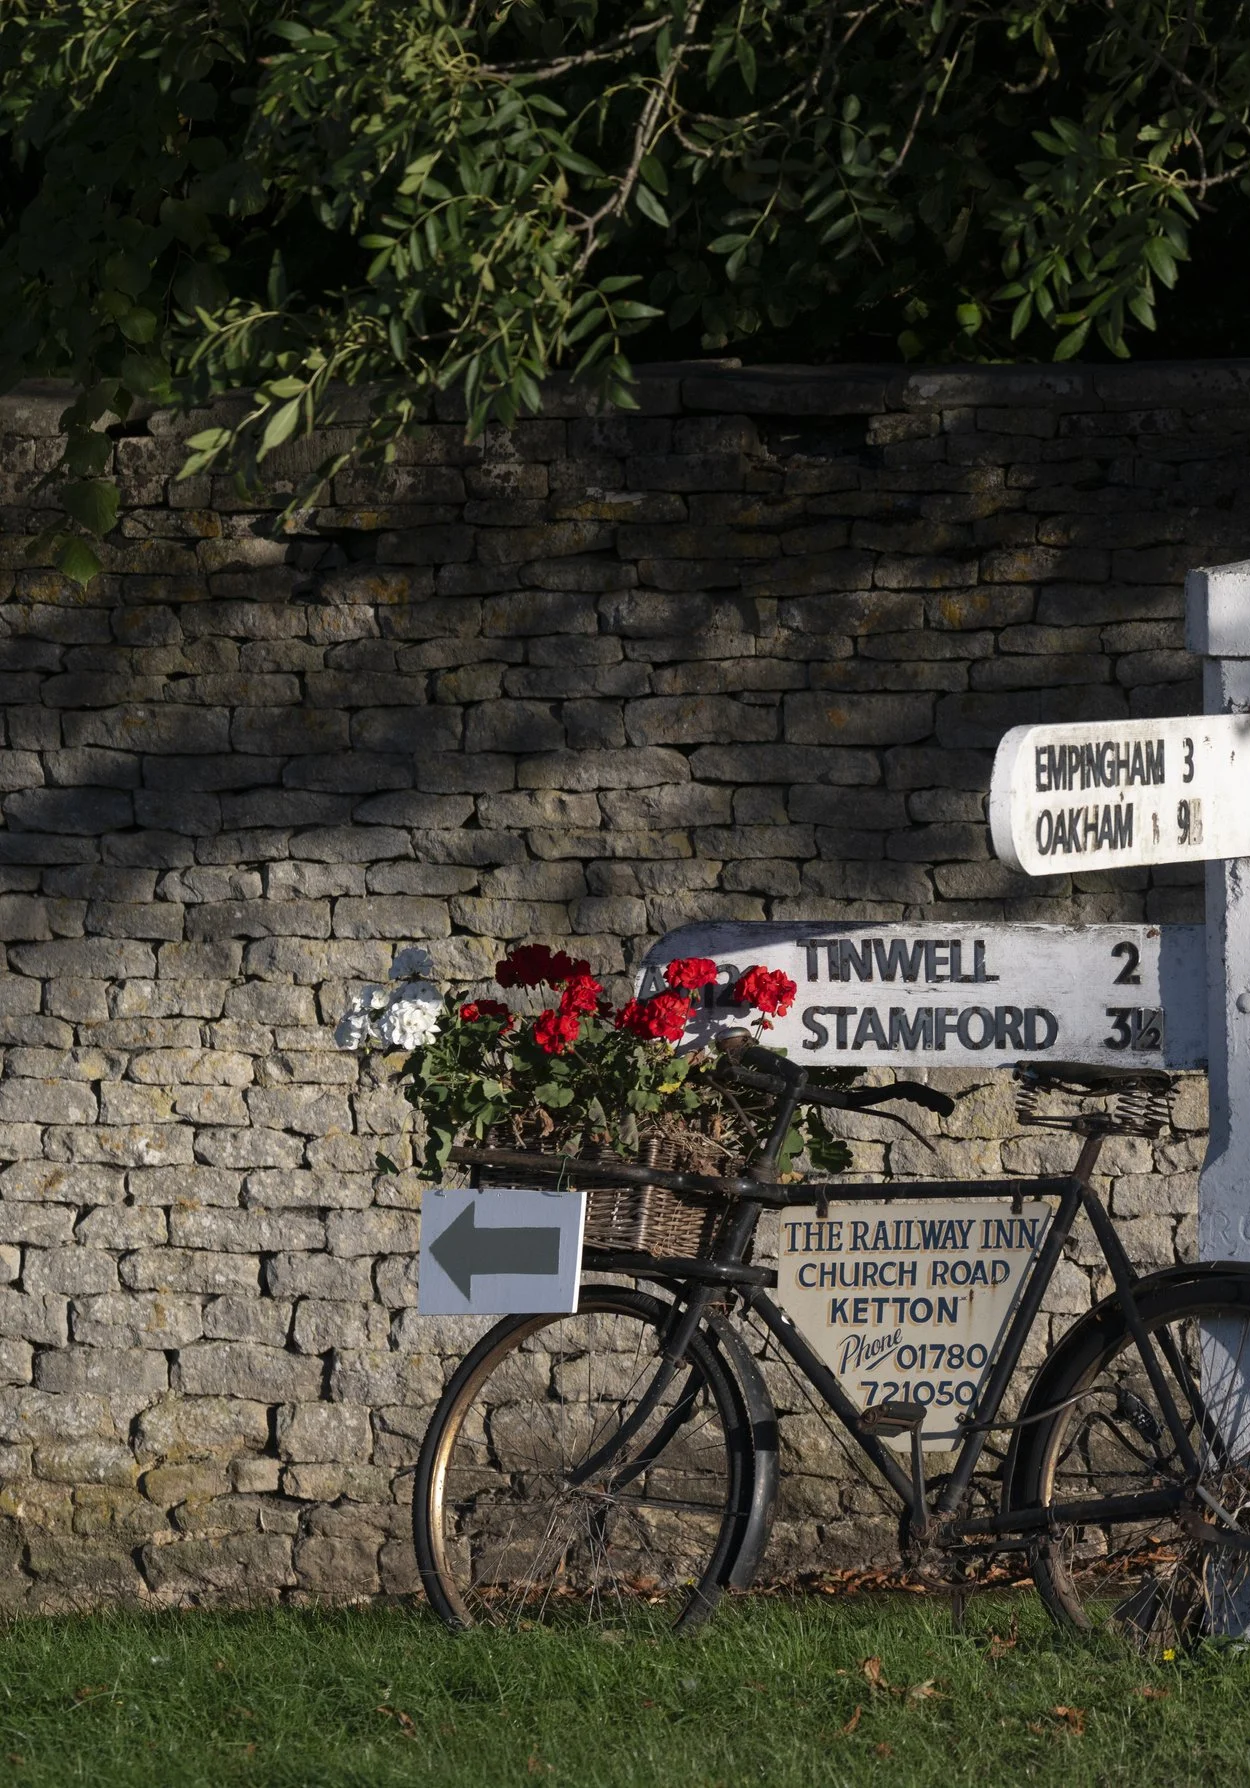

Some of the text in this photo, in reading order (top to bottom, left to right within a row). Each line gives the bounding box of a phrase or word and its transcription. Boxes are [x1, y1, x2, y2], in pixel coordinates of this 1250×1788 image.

[1035, 738, 1194, 792] EMPINGHAM 3
[1036, 803, 1134, 856] OAKHAM
[797, 938, 1141, 984] TINWELL 2
[802, 1006, 1059, 1050] STAMFORD
[784, 1217, 1040, 1252] THE RAILWAY INN
[798, 1259, 1011, 1288] CHURCH ROAD
[830, 1296, 959, 1324] KETTON
[839, 1328, 988, 1374] Phone 01780
[860, 1380, 978, 1408] 721050
